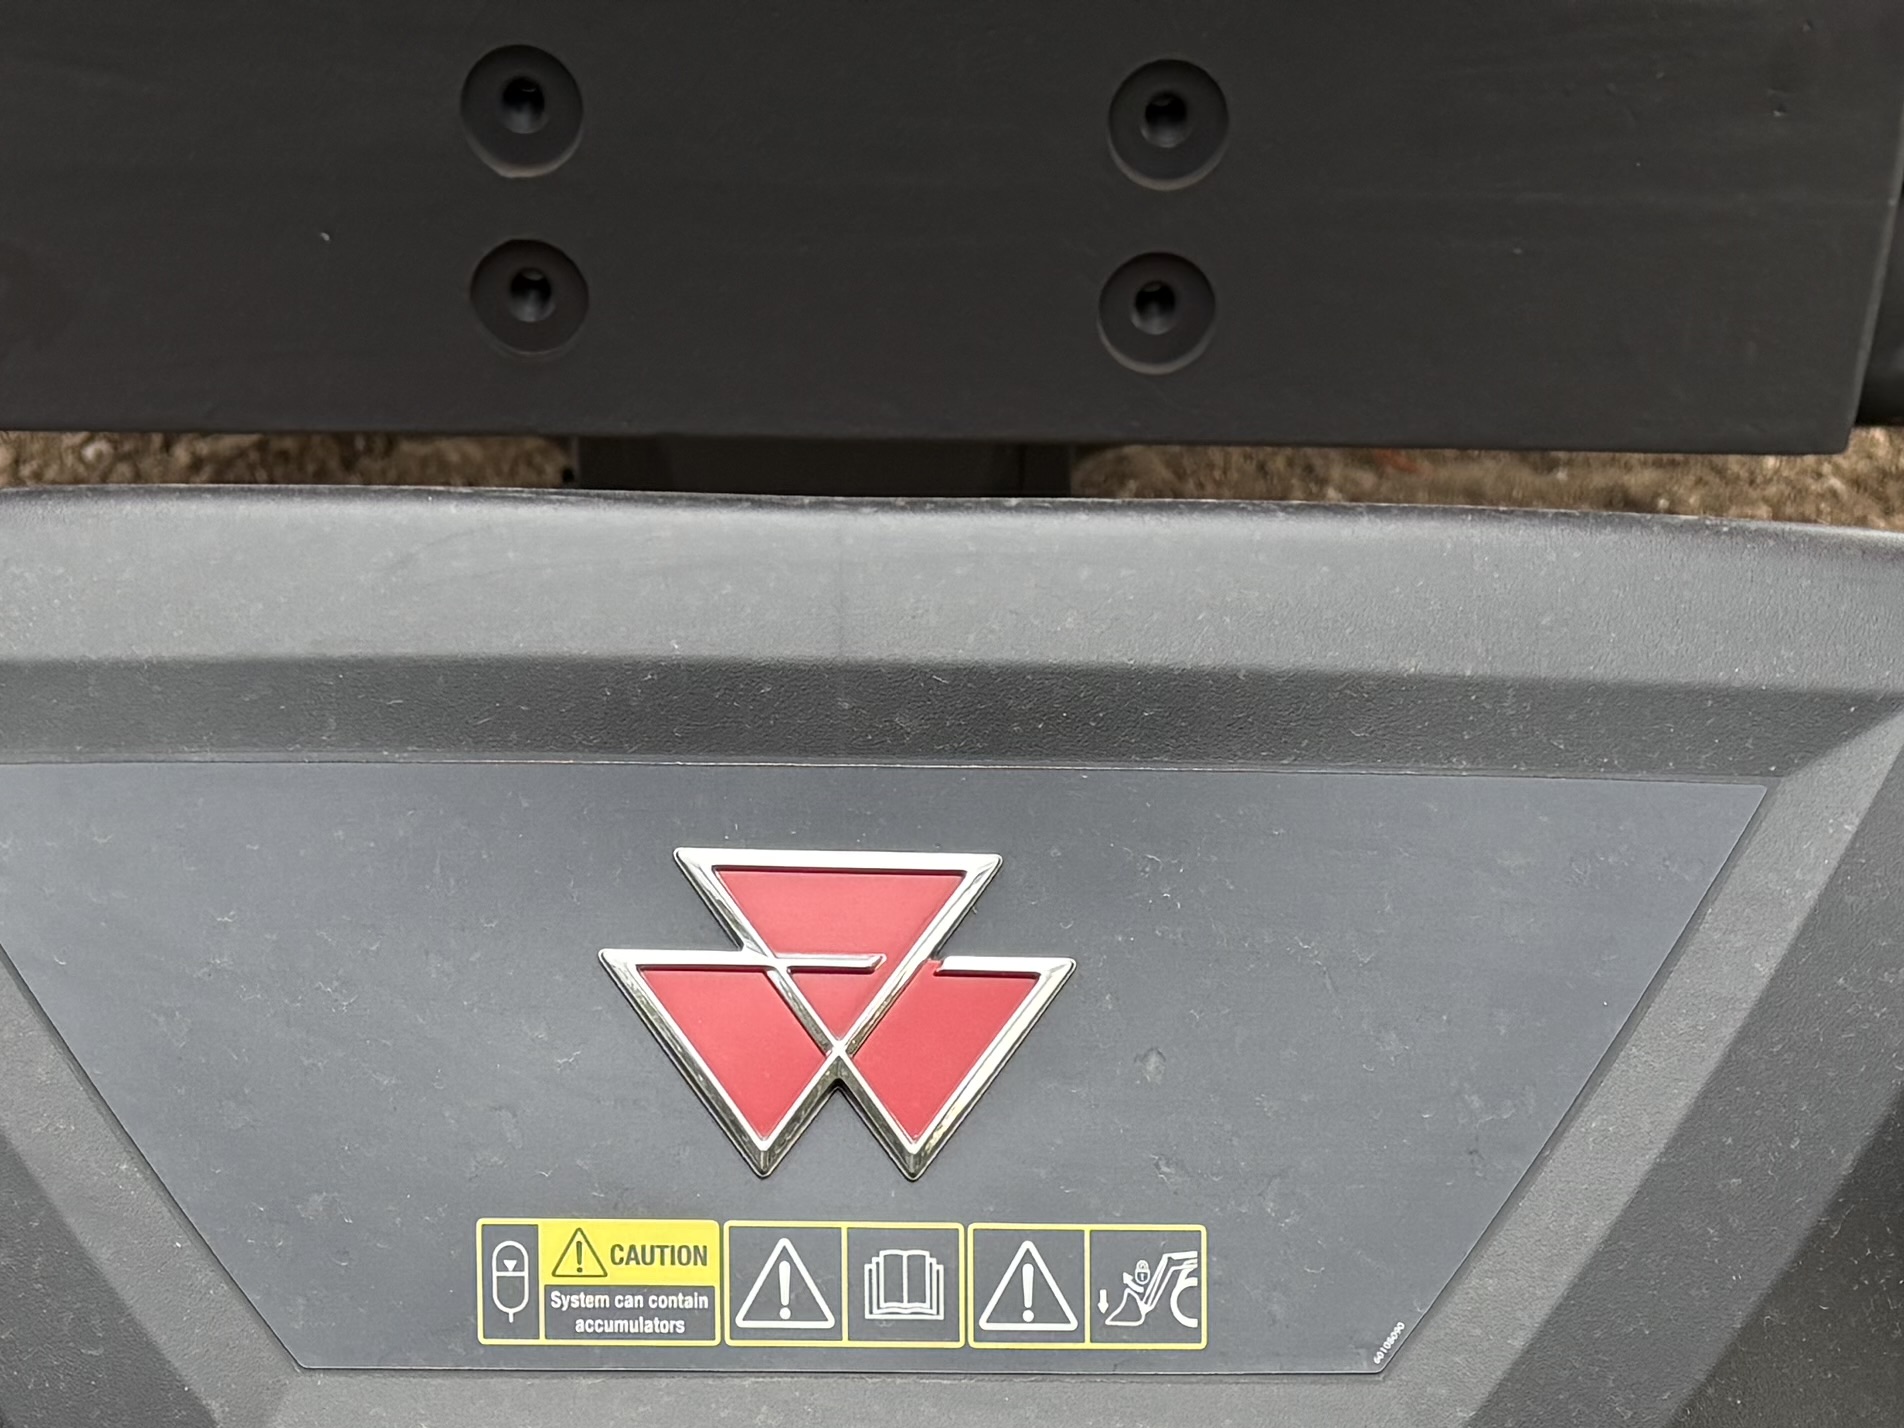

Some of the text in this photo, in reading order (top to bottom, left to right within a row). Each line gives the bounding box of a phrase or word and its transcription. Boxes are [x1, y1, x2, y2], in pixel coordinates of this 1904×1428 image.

[610, 1243, 708, 1267] CAUTION
[550, 1290, 709, 1312] System can contain
[575, 1316, 685, 1334] accumulators
[1373, 1321, 1405, 1365] 60108090
